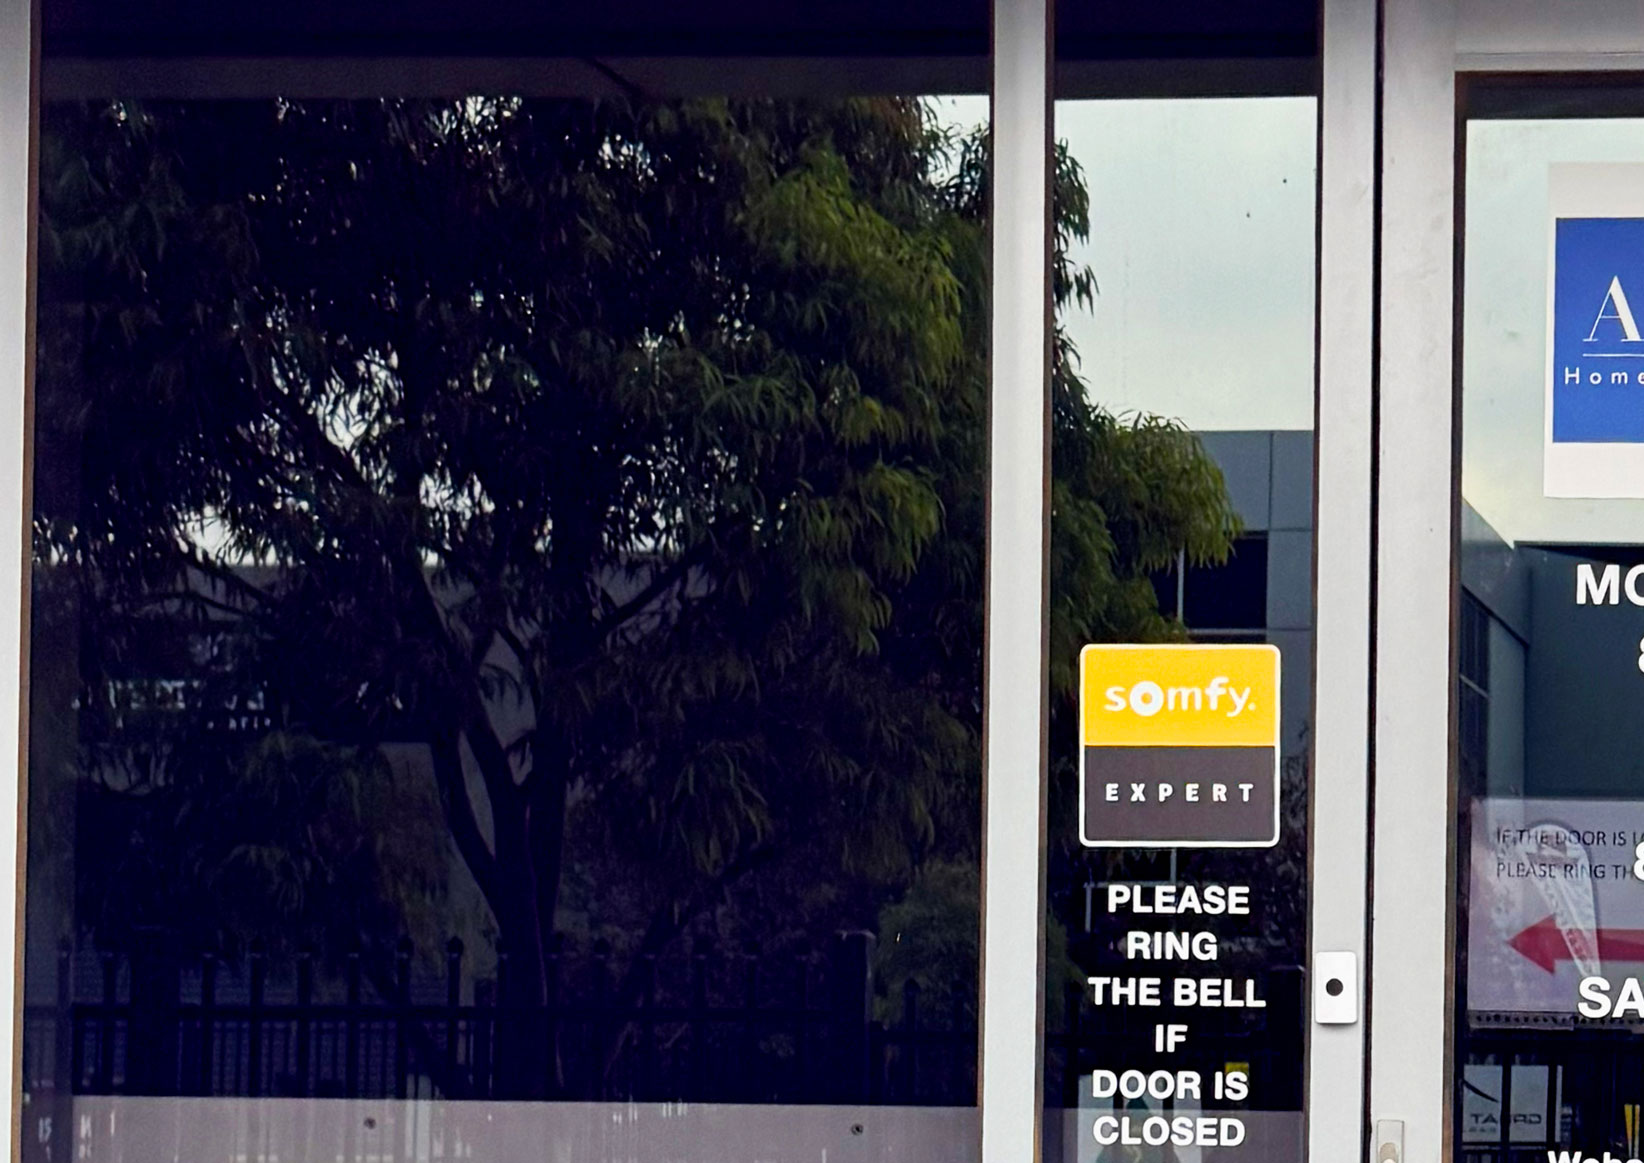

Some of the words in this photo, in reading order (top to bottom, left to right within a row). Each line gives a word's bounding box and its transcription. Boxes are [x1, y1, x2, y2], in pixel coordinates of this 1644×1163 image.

[1105, 782, 1254, 802] EXPERT
[1555, 830, 1607, 846] DOOR
[1613, 831, 1627, 846] IS
[1564, 863, 1606, 879] RING
[1108, 884, 1250, 915] PLEASE
[1127, 931, 1218, 961] RING
[1087, 976, 1161, 1006] THE
[1173, 978, 1267, 1008] BELL
[1155, 1024, 1188, 1053] IF
[1092, 1069, 1201, 1100] DOOR
[1214, 1071, 1248, 1101] IS
[1092, 1115, 1245, 1147] CLOSED
